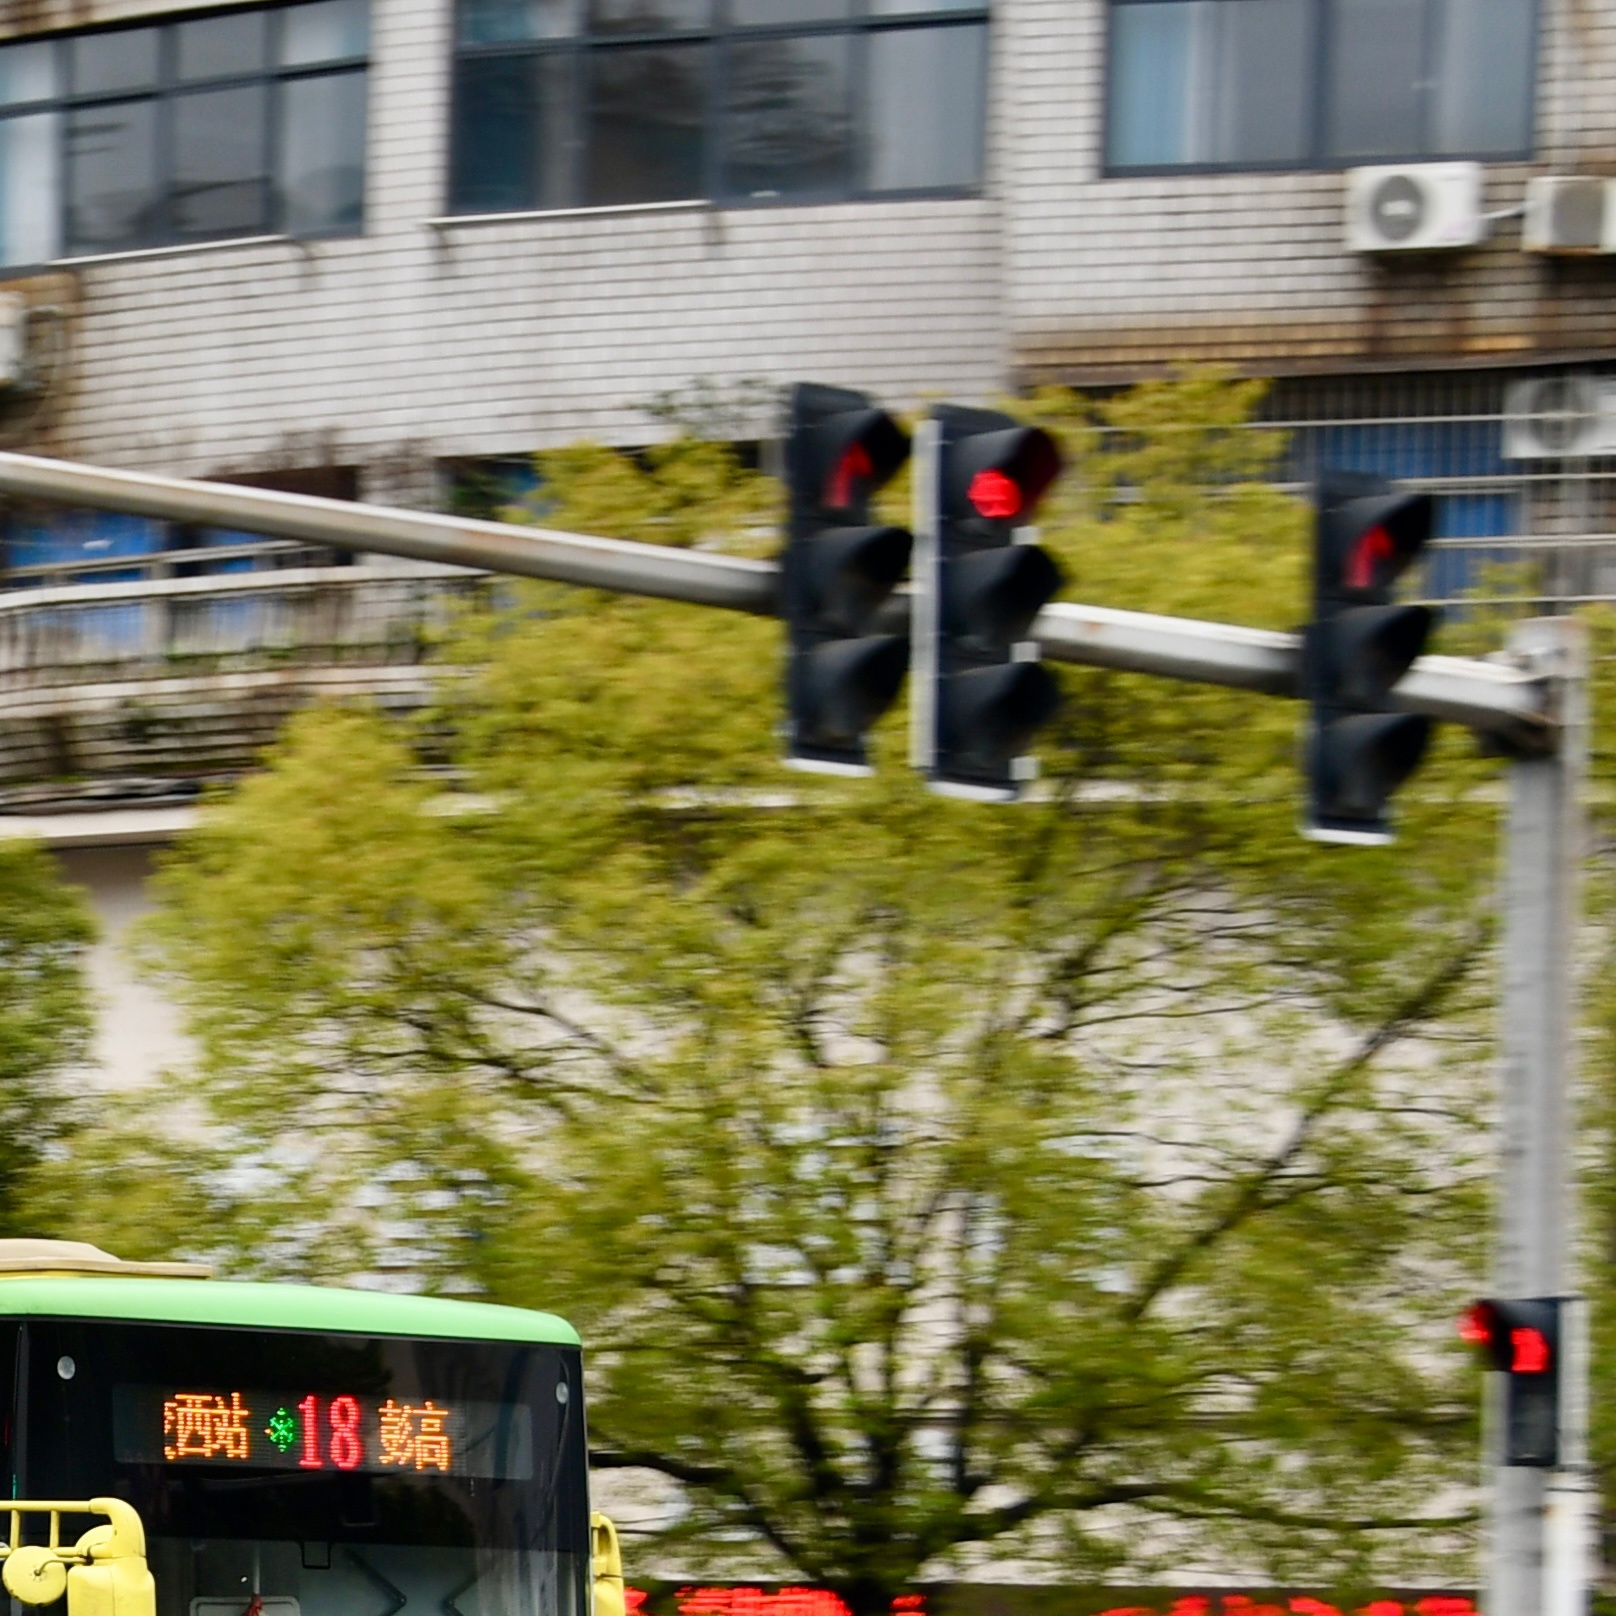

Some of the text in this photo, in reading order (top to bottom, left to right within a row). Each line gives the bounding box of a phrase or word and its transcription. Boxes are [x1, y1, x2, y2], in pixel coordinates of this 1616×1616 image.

[164, 1391, 449, 1472] 西站 18 彭高
